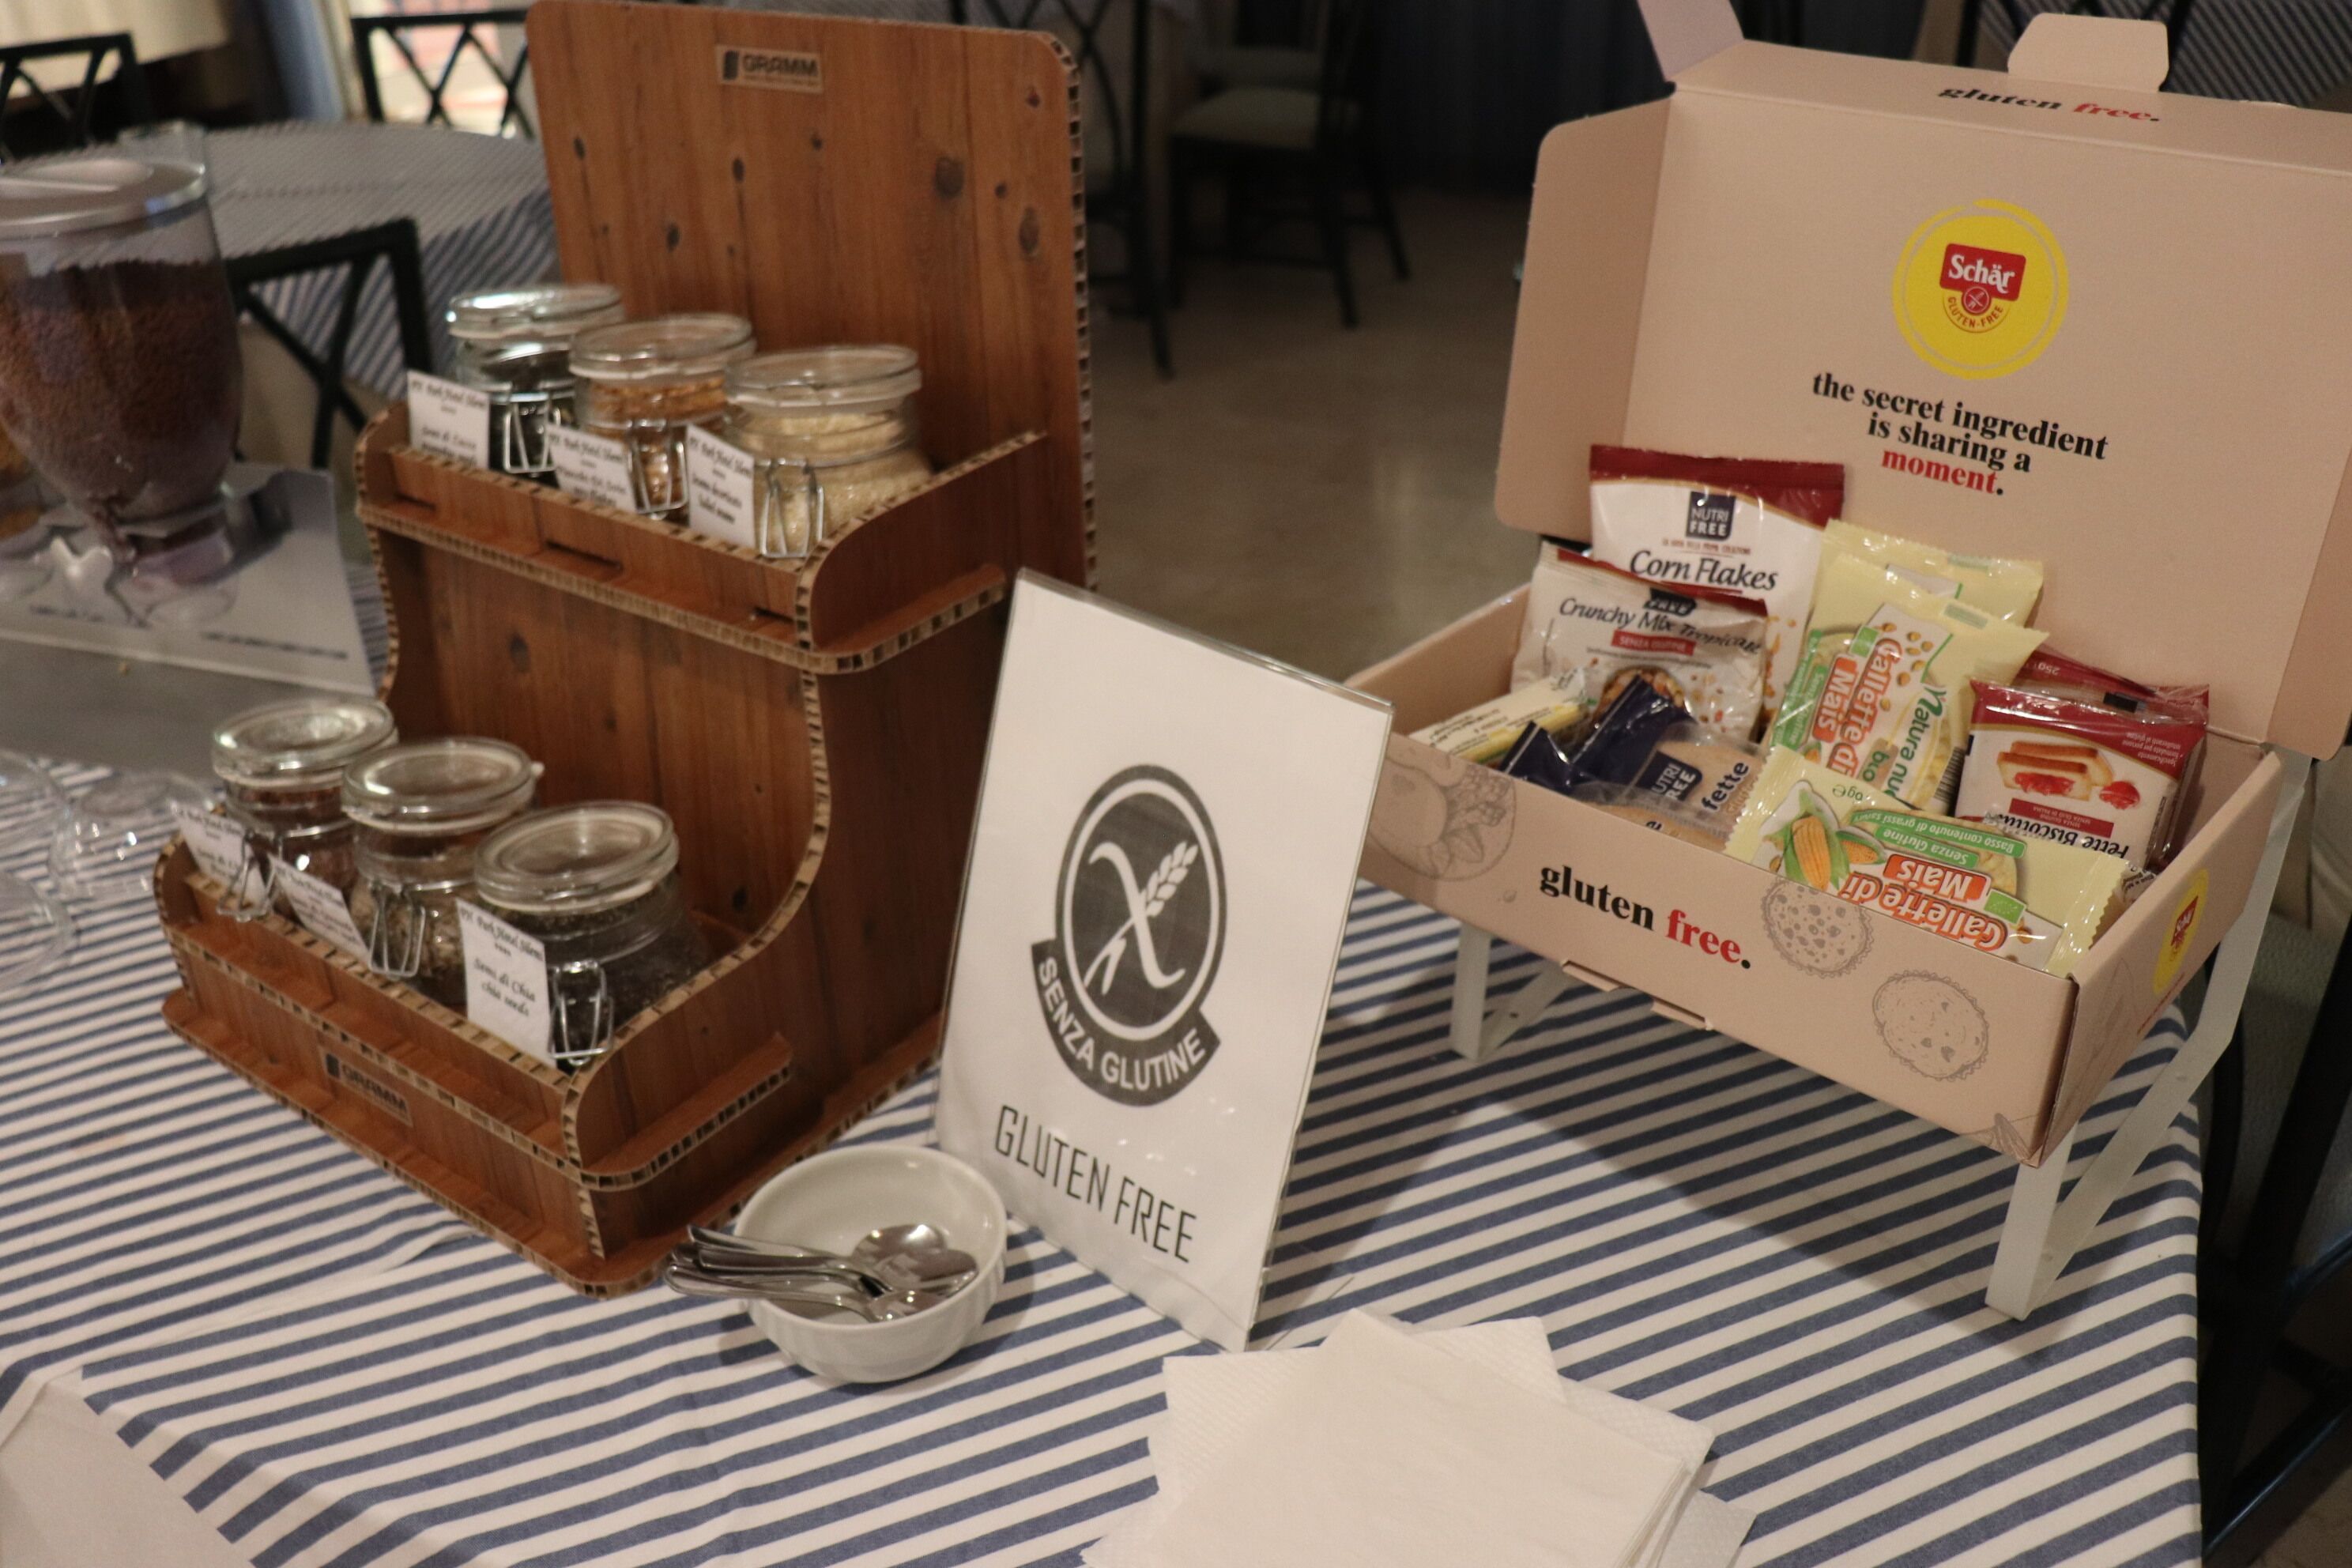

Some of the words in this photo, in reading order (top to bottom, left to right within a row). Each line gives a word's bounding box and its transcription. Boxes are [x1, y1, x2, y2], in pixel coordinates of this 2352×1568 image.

[1939, 86, 2062, 110] gluten
[2073, 102, 2160, 122] free.
[1948, 253, 2015, 294] Schär
[1947, 296, 2004, 329] GLUTEN-FREE
[1812, 372, 1854, 401] the
[1862, 386, 1945, 423] secret
[1952, 401, 2109, 460] ingredient
[1867, 412, 1890, 438] is
[1898, 422, 2007, 472] sharing
[2013, 451, 2031, 473] a
[1881, 448, 2004, 496] moment.
[1689, 521, 1728, 537] FREE
[1690, 508, 1730, 522] NUTRI
[1630, 550, 1690, 581] Corn
[1694, 557, 1778, 590] Flakes
[1559, 597, 1636, 630] Crunchy
[1638, 612, 1675, 632] Mix
[1818, 669, 1856, 731] Mais
[1843, 639, 1902, 741] Gallette
[1651, 763, 1683, 796] UTRI
[1664, 769, 1697, 801] REE
[1702, 762, 1750, 812] fette
[1883, 829, 1928, 852] Glutine
[1917, 821, 1928, 832] di
[1929, 824, 1982, 845] contenuto
[1984, 837, 2015, 854] Basso
[1930, 844, 1969, 865] Senza
[1841, 875, 1879, 903] di
[1897, 860, 1973, 900] Mais
[1540, 865, 1655, 932] gluten
[1666, 909, 1751, 970] free.
[1882, 884, 2003, 949] Gallette
[1038, 956, 1095, 1070] SENZA
[1100, 1027, 1208, 1093] GLUTINE
[994, 1104, 1110, 1213] GLUTEN
[1114, 1176, 1197, 1265] FREE
